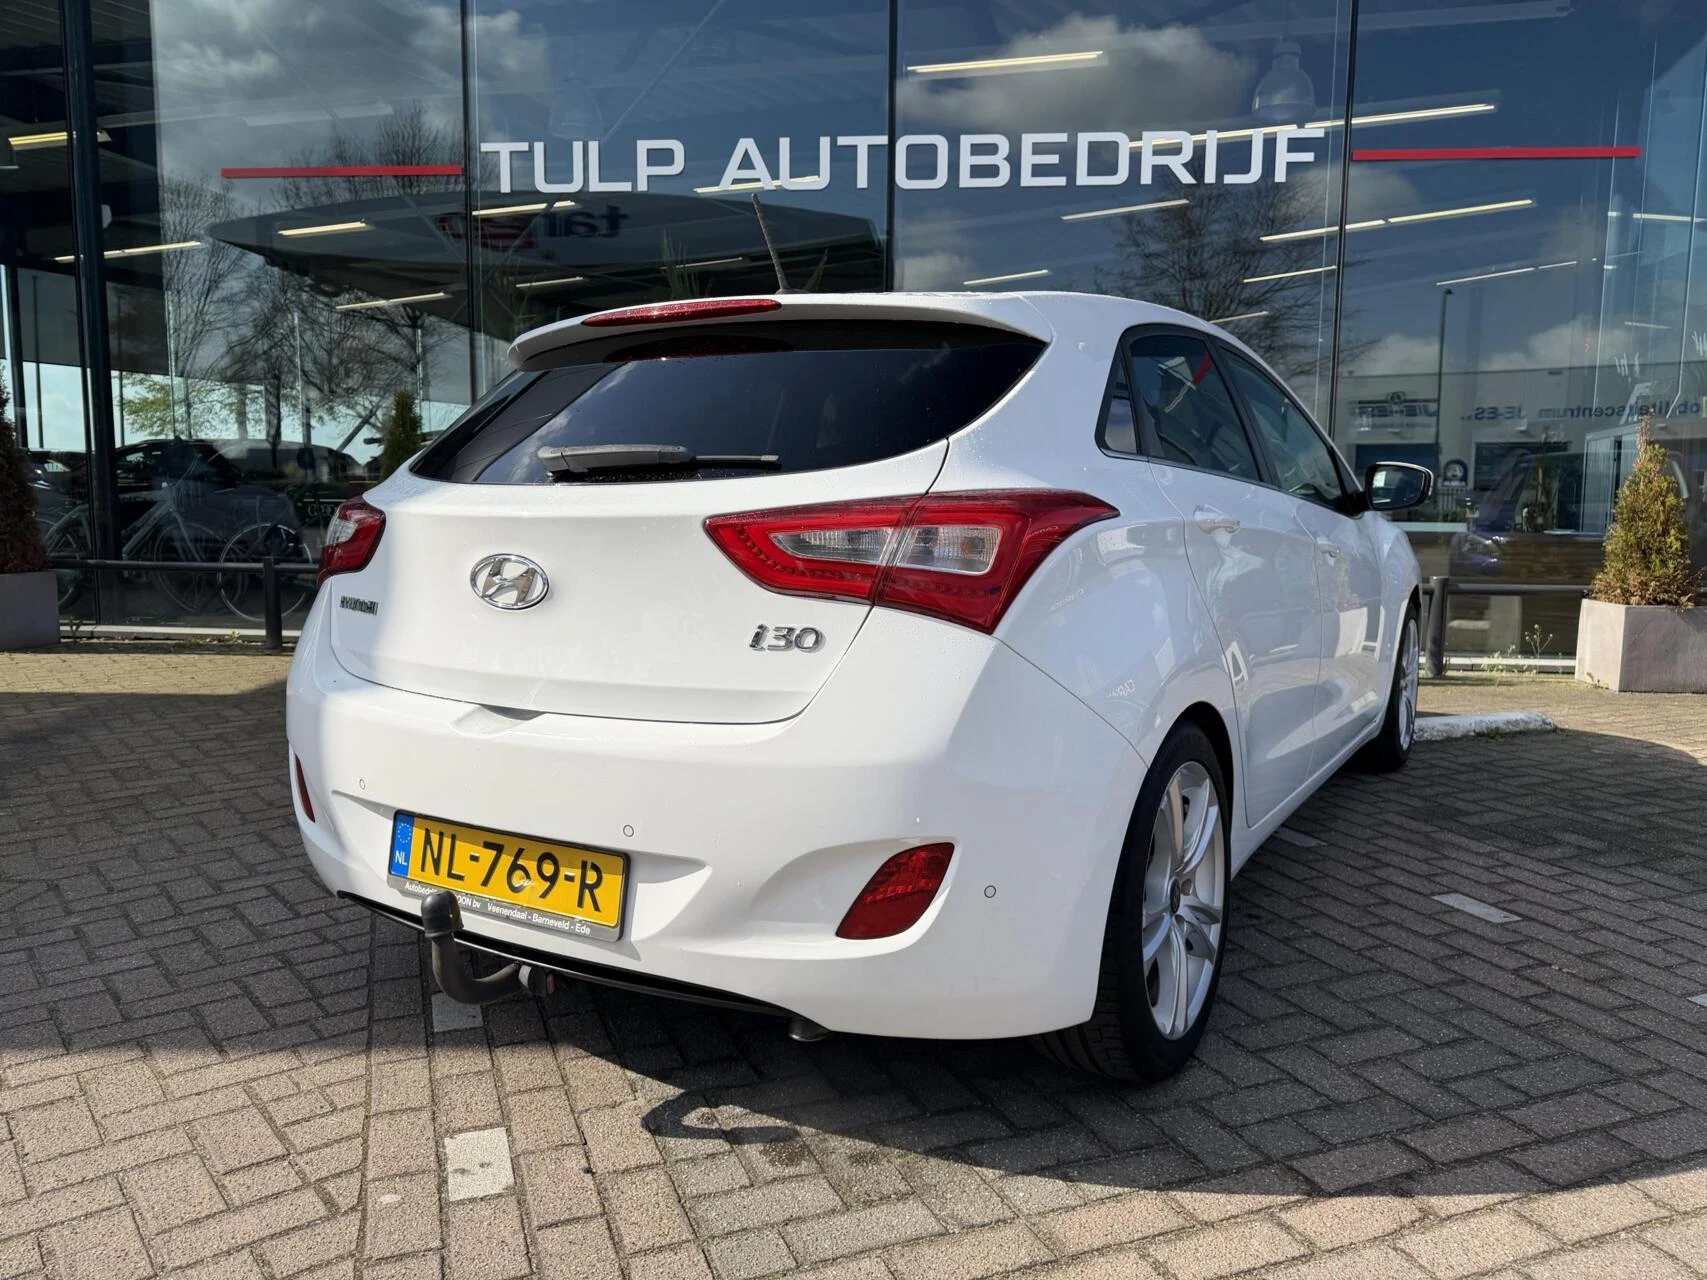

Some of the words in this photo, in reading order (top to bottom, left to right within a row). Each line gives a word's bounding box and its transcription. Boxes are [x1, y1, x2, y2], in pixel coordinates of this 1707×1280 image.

[480, 139, 685, 194] TULP
[718, 128, 1325, 190] AUTOBEDRIJF
[749, 624, 824, 651] i30
[395, 850, 408, 866] NL
[420, 827, 603, 913] NL-769-R
[487, 902, 527, 920] Veenendaal
[532, 913, 569, 930] Barneveld
[575, 923, 591, 935] Ede
